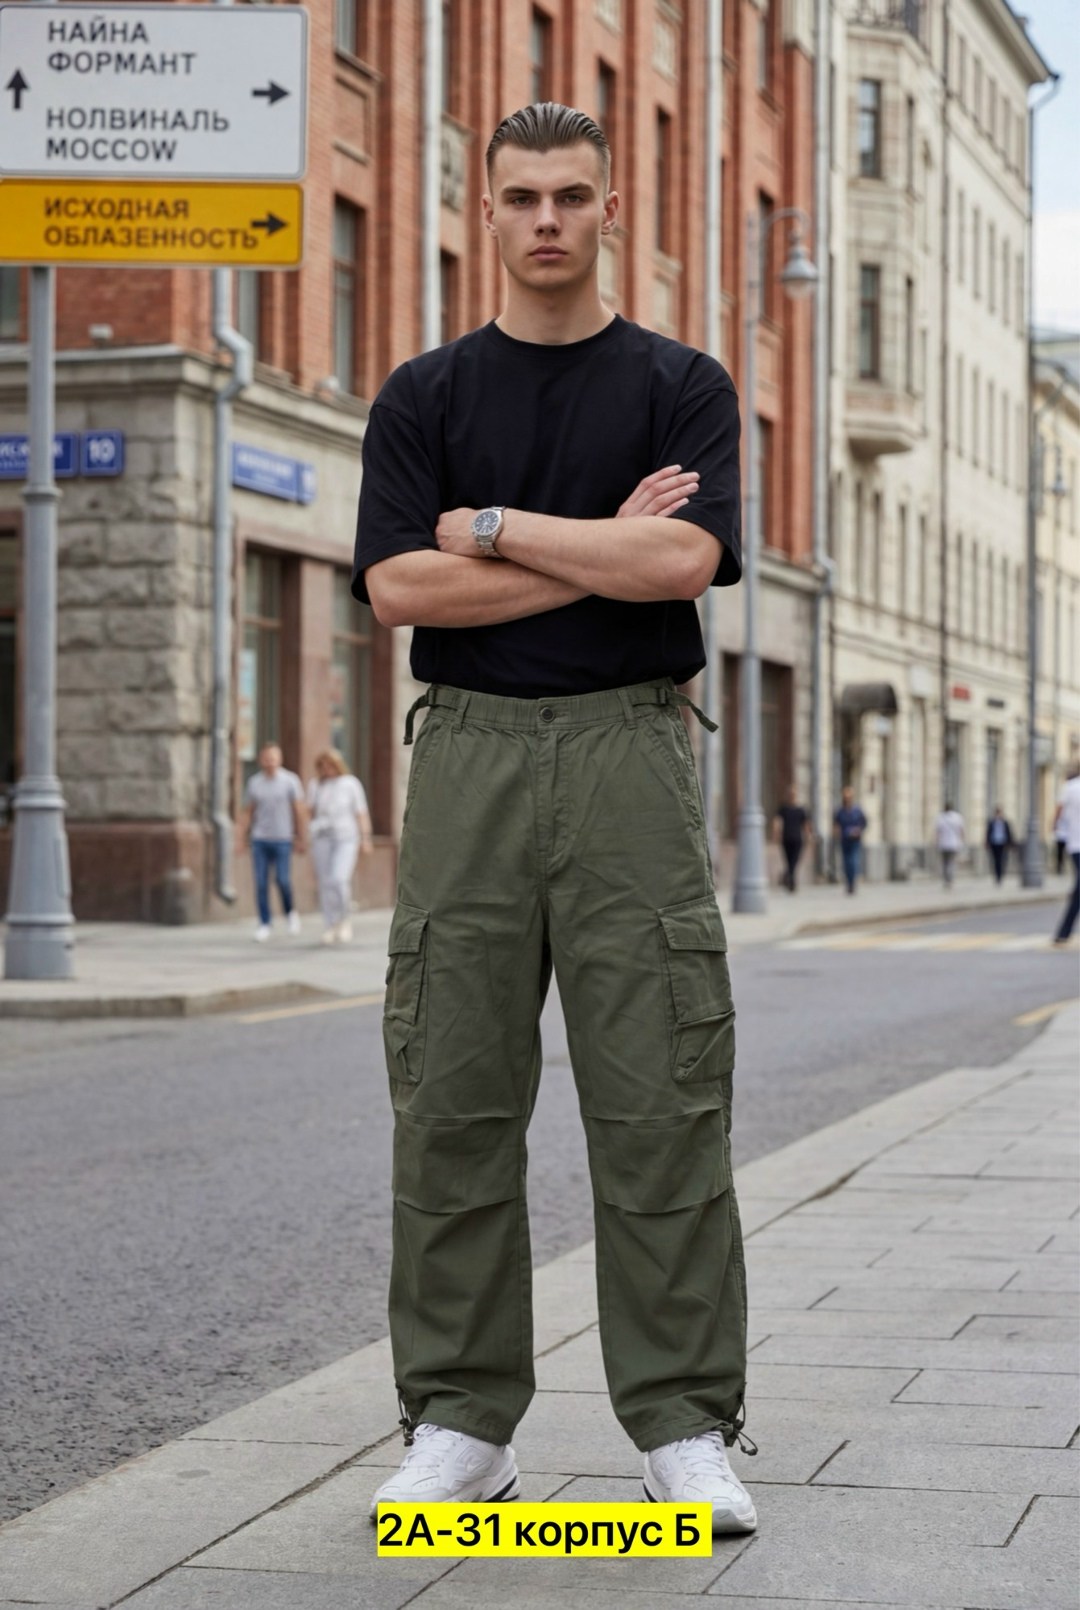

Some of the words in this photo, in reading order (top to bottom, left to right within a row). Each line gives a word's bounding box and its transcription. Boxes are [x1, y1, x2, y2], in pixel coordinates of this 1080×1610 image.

[48, 16, 149, 44] НАЙНА
[48, 51, 197, 75] ФОРМАНТ
[47, 108, 230, 132] НОЛВИНАЛЬ
[47, 138, 177, 161] MOCCOW
[44, 197, 189, 221] ИСХОДНАЯ
[44, 226, 259, 250] ОБЛАЗЕННОСТЬ
